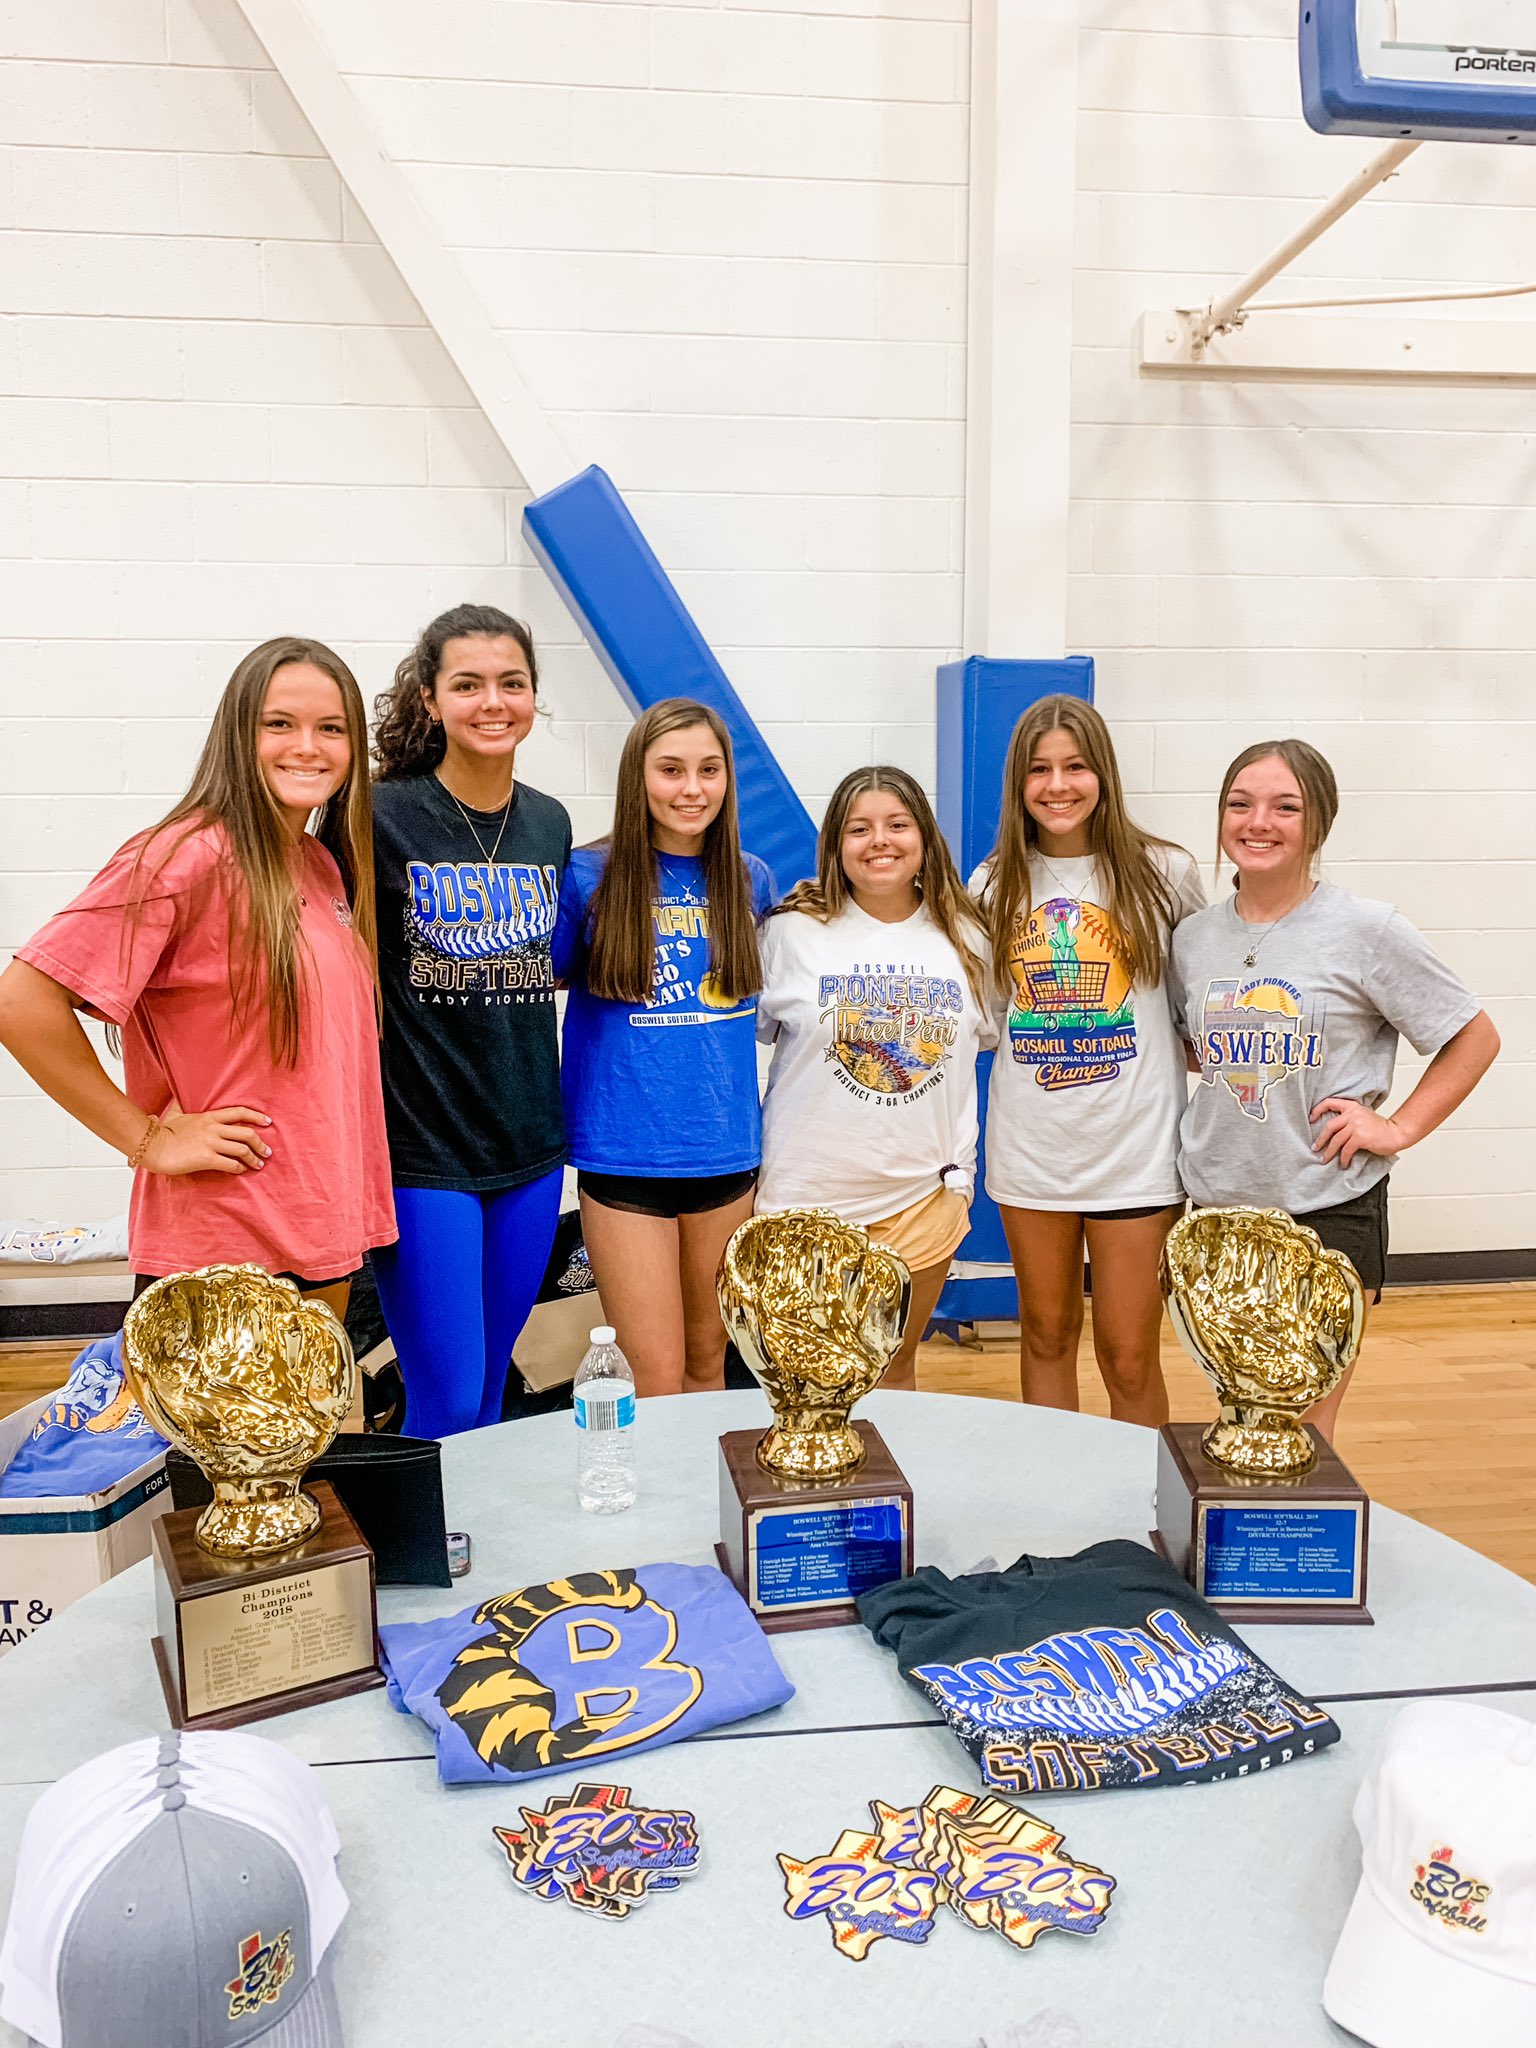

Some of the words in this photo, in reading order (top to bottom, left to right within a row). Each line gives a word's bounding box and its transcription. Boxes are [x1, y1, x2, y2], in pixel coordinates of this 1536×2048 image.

[1012, 932, 1047, 956] THING!
[853, 963, 926, 975] BOSWELL
[418, 993, 469, 1006] LADY
[818, 974, 964, 1014] PIONEERS
[1239, 979, 1261, 995] LADY
[1262, 977, 1302, 1001] PIONEERS
[631, 1016, 666, 1025] BOSWELL
[667, 1014, 700, 1023] SOFTBALL
[819, 1005, 898, 1044] Three
[892, 1008, 959, 1047] Peat
[1014, 1038, 1067, 1054] BOSWELL
[1072, 1034, 1133, 1054] SOFTBALL
[1047, 1054, 1082, 1063] REGIONAL
[1083, 1052, 1116, 1063] QUARTER
[833, 1068, 871, 1102] DISTRICT
[903, 1071, 945, 1105] CHAMPIONS
[1035, 1063, 1117, 1087] Champs
[145, 1476, 164, 1495] FOR
[793, 1517, 821, 1525] BOSWELL
[240, 1590, 313, 1614] Champions
[242, 1579, 311, 1602] Bi-District
[262, 1605, 293, 1619] 2018
[909, 1608, 1207, 1707] BOSWELL
[982, 1699, 1330, 1796] SOFTBALL
[541, 1811, 677, 1867] BOS
[792, 1863, 937, 1918] BOS
[964, 1851, 1113, 1911] BOS
[828, 1902, 930, 1943] Softball
[1001, 1890, 1104, 1933] Softball
